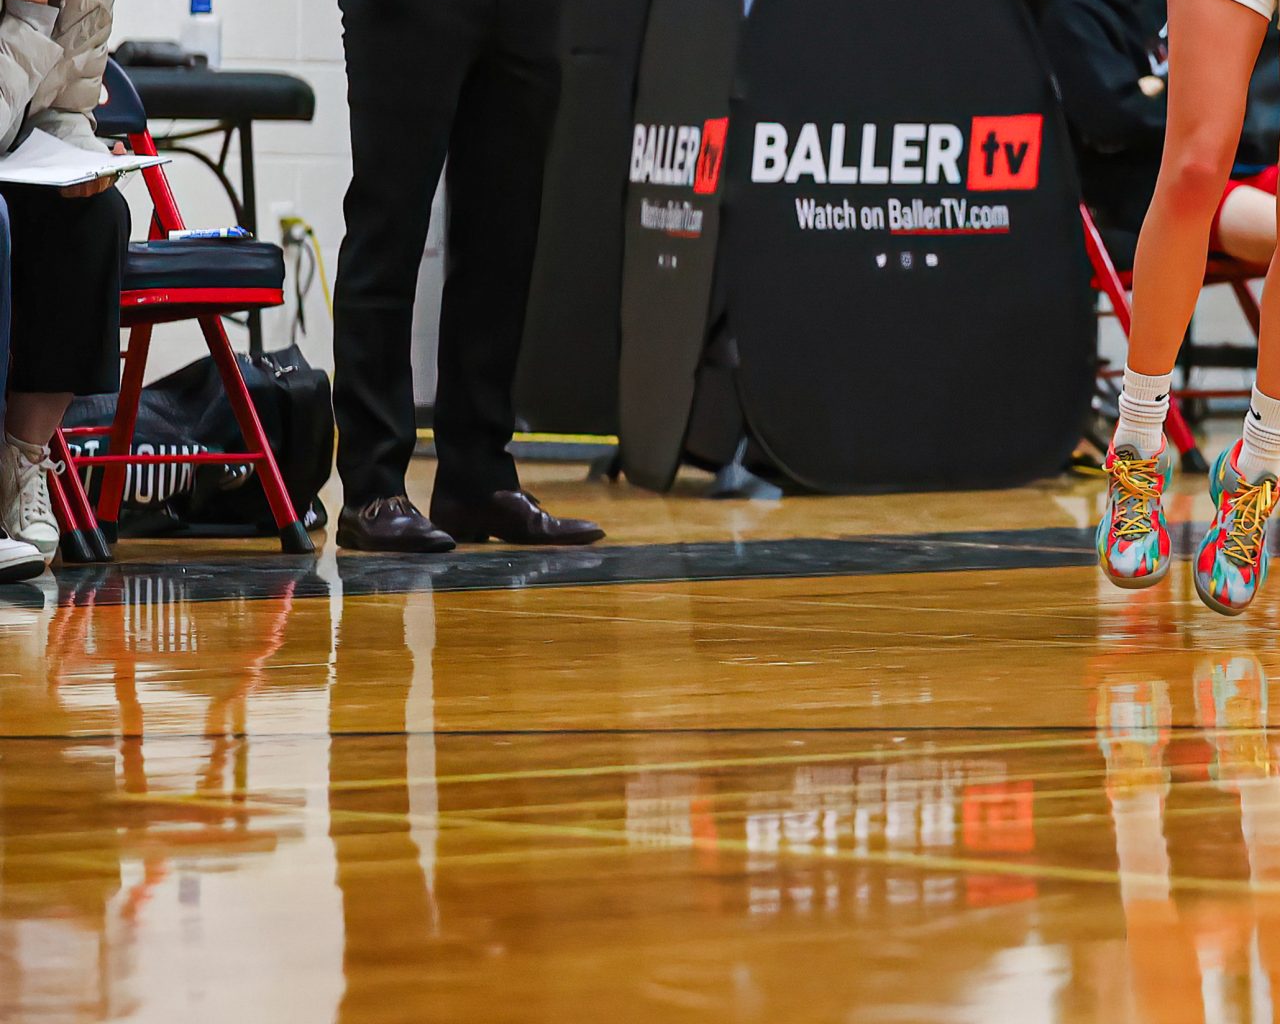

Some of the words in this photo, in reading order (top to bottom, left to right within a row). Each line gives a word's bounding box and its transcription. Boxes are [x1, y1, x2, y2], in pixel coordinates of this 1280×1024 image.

[629, 123, 701, 187] BALLER
[751, 122, 964, 184] BALLER
[981, 131, 1030, 176] tv
[795, 197, 857, 230] Watch
[861, 204, 885, 230] on
[888, 198, 1009, 231] BallerTV.com
